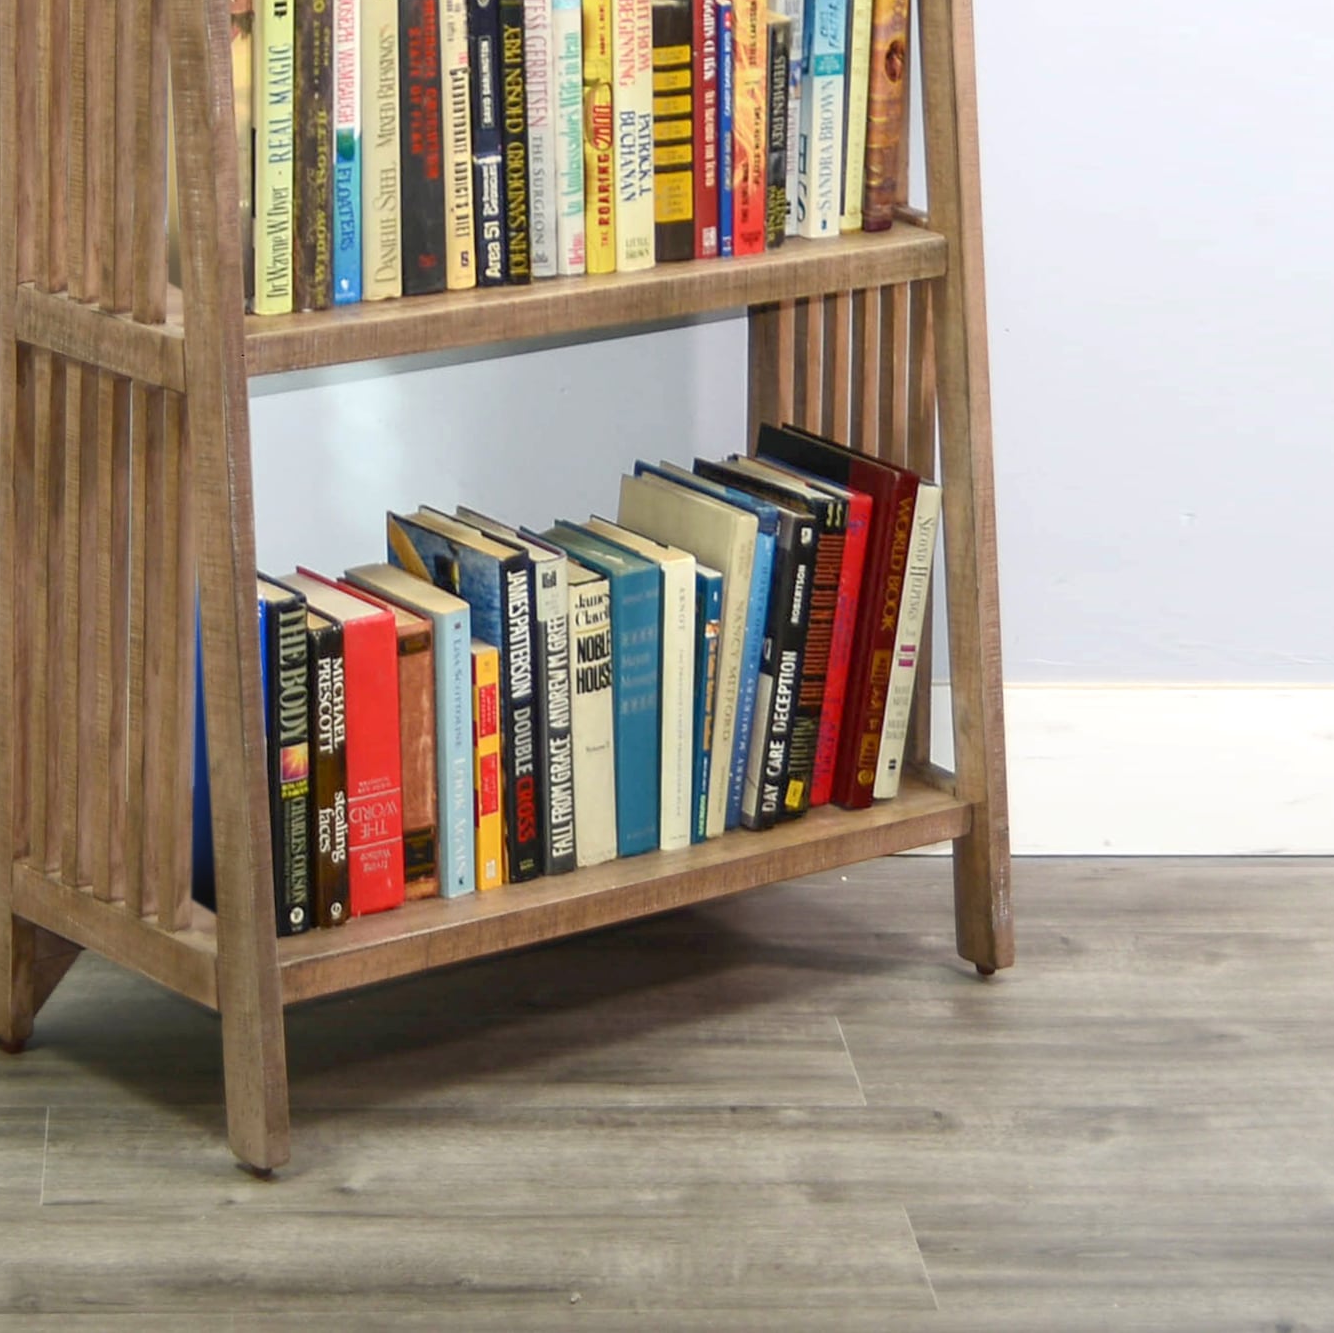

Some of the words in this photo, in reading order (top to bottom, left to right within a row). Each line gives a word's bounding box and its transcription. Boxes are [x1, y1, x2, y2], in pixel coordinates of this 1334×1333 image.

[375, 32, 395, 100] BLESSINGS
[480, 40, 491, 95] DARLINGTON
[503, 22, 522, 65] PREY
[637, 26, 651, 72] FROM
[703, 40, 716, 81] CLARK
[267, 42, 293, 105] MAGIC
[337, 47, 355, 125] WAMBAUGH
[505, 67, 524, 133] CHOSEN
[526, 34, 548, 127] GERRITSEN
[771, 55, 786, 115] STEPHEN
[268, 112, 293, 165] REAL
[374, 102, 396, 150] MIXED
[481, 97, 492, 124] DAVID
[591, 105, 612, 150] 2000
[771, 116, 785, 149] FREY
[818, 79, 835, 142] BROWN
[531, 135, 544, 164] THE
[619, 110, 636, 202] BUCHANAN
[638, 113, 652, 183] PATRICK
[265, 185, 292, 217] Dyer
[371, 161, 397, 212] STEEL
[505, 141, 527, 229] SANDFORD
[596, 153, 611, 227] ROARING
[816, 143, 833, 211] SANDRA
[335, 166, 356, 252] FLOATERS
[453, 214, 471, 239] DIET
[483, 220, 500, 240] 51
[532, 166, 546, 245] SURGEON
[266, 235, 291, 283] Wayne
[373, 217, 398, 284] DANIELLE
[484, 242, 501, 278] Area
[507, 231, 529, 276] JOHN
[811, 533, 846, 585] PROOF
[890, 496, 914, 571] WORLD
[915, 515, 936, 563] SECOND
[506, 569, 530, 617] JAMES
[790, 564, 806, 624] ROBERTSON
[809, 589, 839, 606] OF
[880, 574, 903, 632] BOOK
[908, 565, 929, 621] HELPINGS
[278, 605, 308, 665] THE
[730, 599, 745, 659] NANCY
[801, 609, 835, 676] BURDEN
[507, 617, 532, 699] PATTERSON
[279, 664, 308, 742] BODY
[317, 656, 334, 754] PRESCOTT
[332, 656, 346, 749] MICHAEL
[547, 668, 571, 729] ANDREW
[722, 665, 738, 743] MITFORD
[771, 649, 798, 733] DECEPTION
[796, 679, 825, 707] THE
[513, 706, 534, 776] DOUBLE
[549, 733, 572, 783] GRACE
[765, 739, 786, 777] CARE
[551, 783, 573, 822] FROM
[733, 757, 745, 801] LARRY
[761, 782, 780, 813] DAY
[290, 797, 308, 854] CHARLES
[318, 807, 335, 853] faces
[331, 790, 348, 864] stealing
[349, 800, 398, 824] WORD
[360, 819, 389, 840] THE
[515, 775, 536, 844] CROSS
[551, 820, 574, 859] FALL
[290, 854, 308, 903] COLSON
